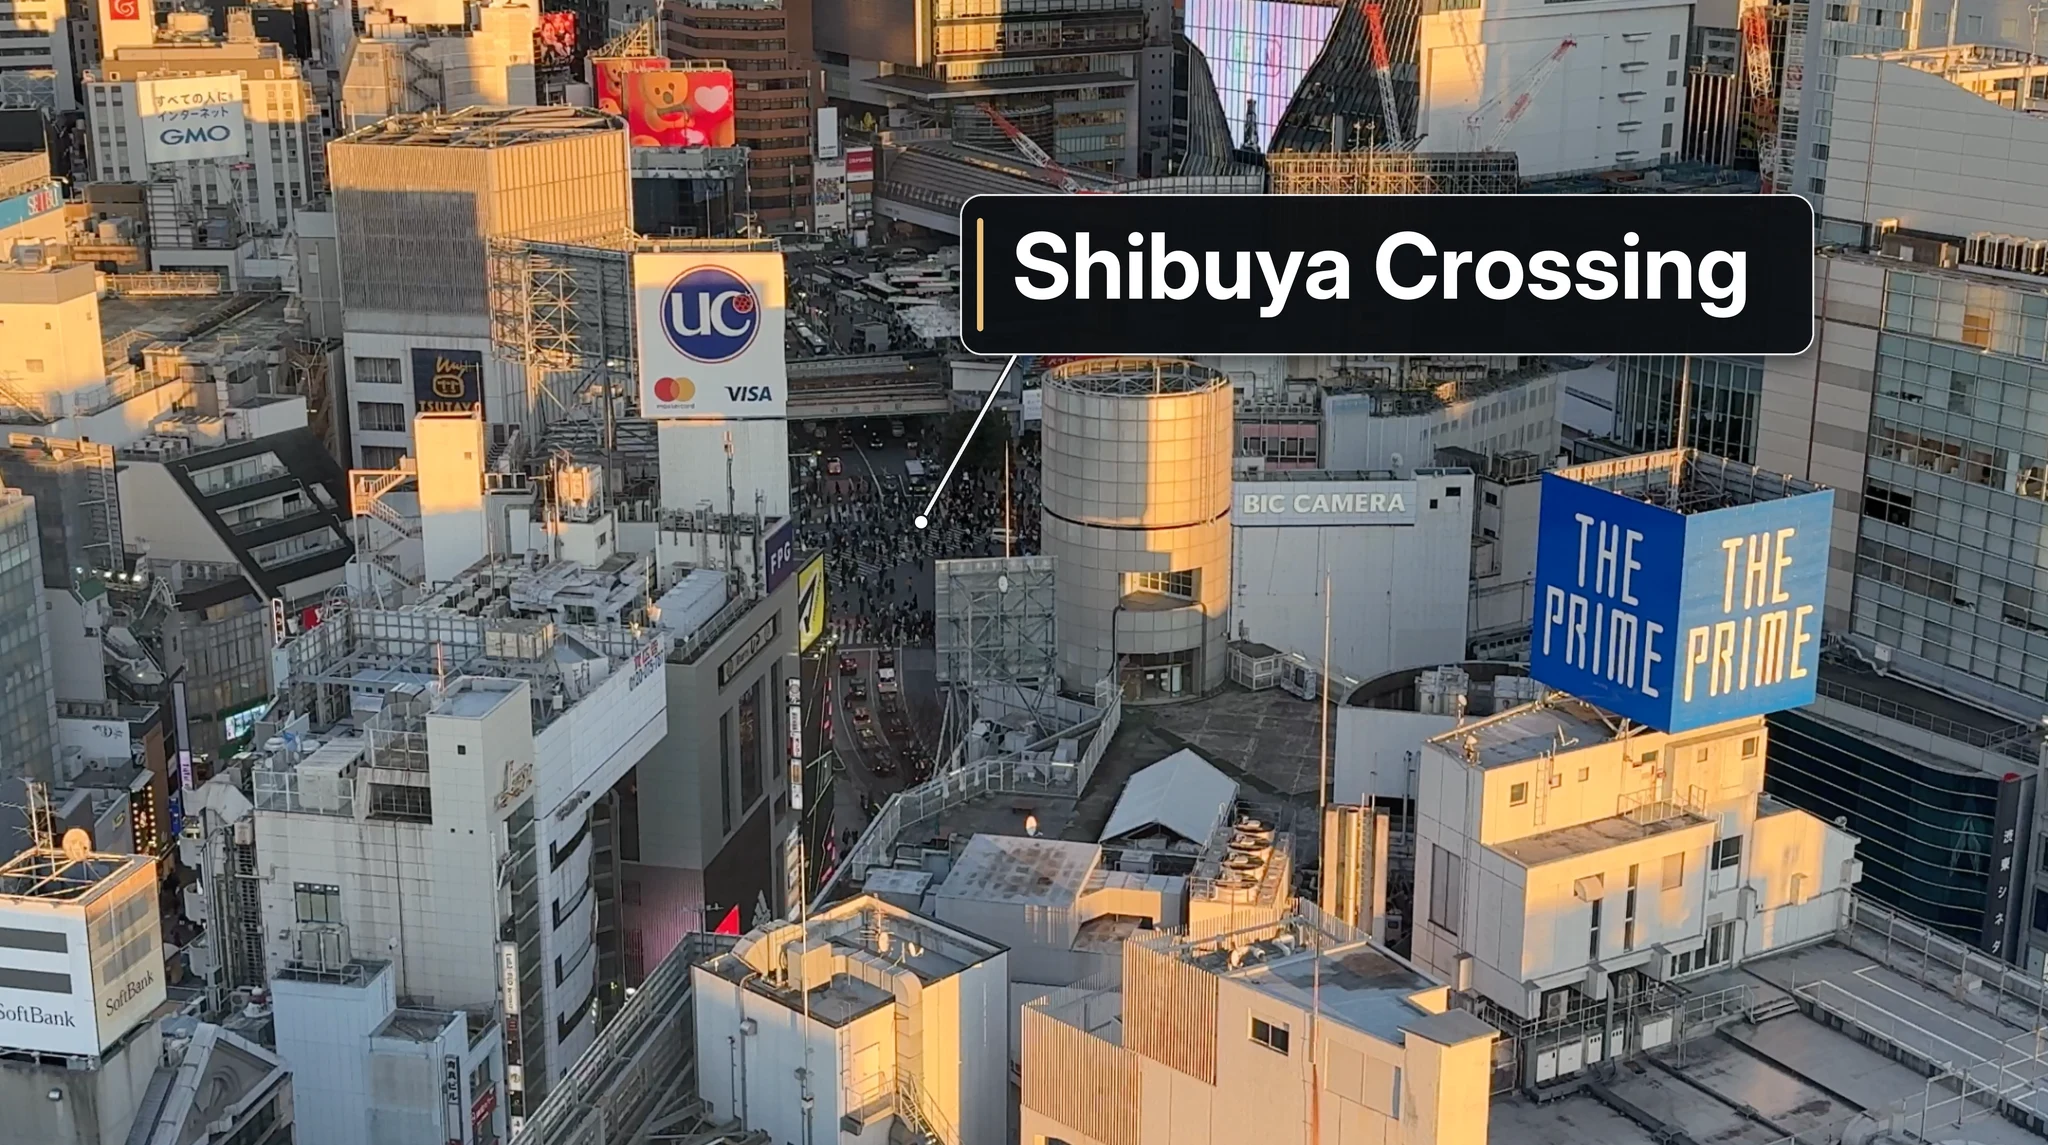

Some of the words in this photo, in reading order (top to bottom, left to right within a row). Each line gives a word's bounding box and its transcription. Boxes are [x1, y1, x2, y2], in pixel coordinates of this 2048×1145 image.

[154, 92, 228, 107] すべての人に
[158, 106, 229, 122] インターネット
[160, 125, 230, 145] GMO
[724, 386, 772, 402] VISA
[1243, 494, 1285, 514] BIC
[1293, 492, 1405, 514] CAMERA
[771, 541, 791, 575] FPG
[1575, 513, 1644, 607] THE
[1722, 527, 1796, 614] THE
[1543, 584, 1664, 698] PRIME
[1684, 604, 1814, 703] PRIME
[106, 970, 155, 1017] SoftBank
[0, 1003, 76, 1028] SoftBank
